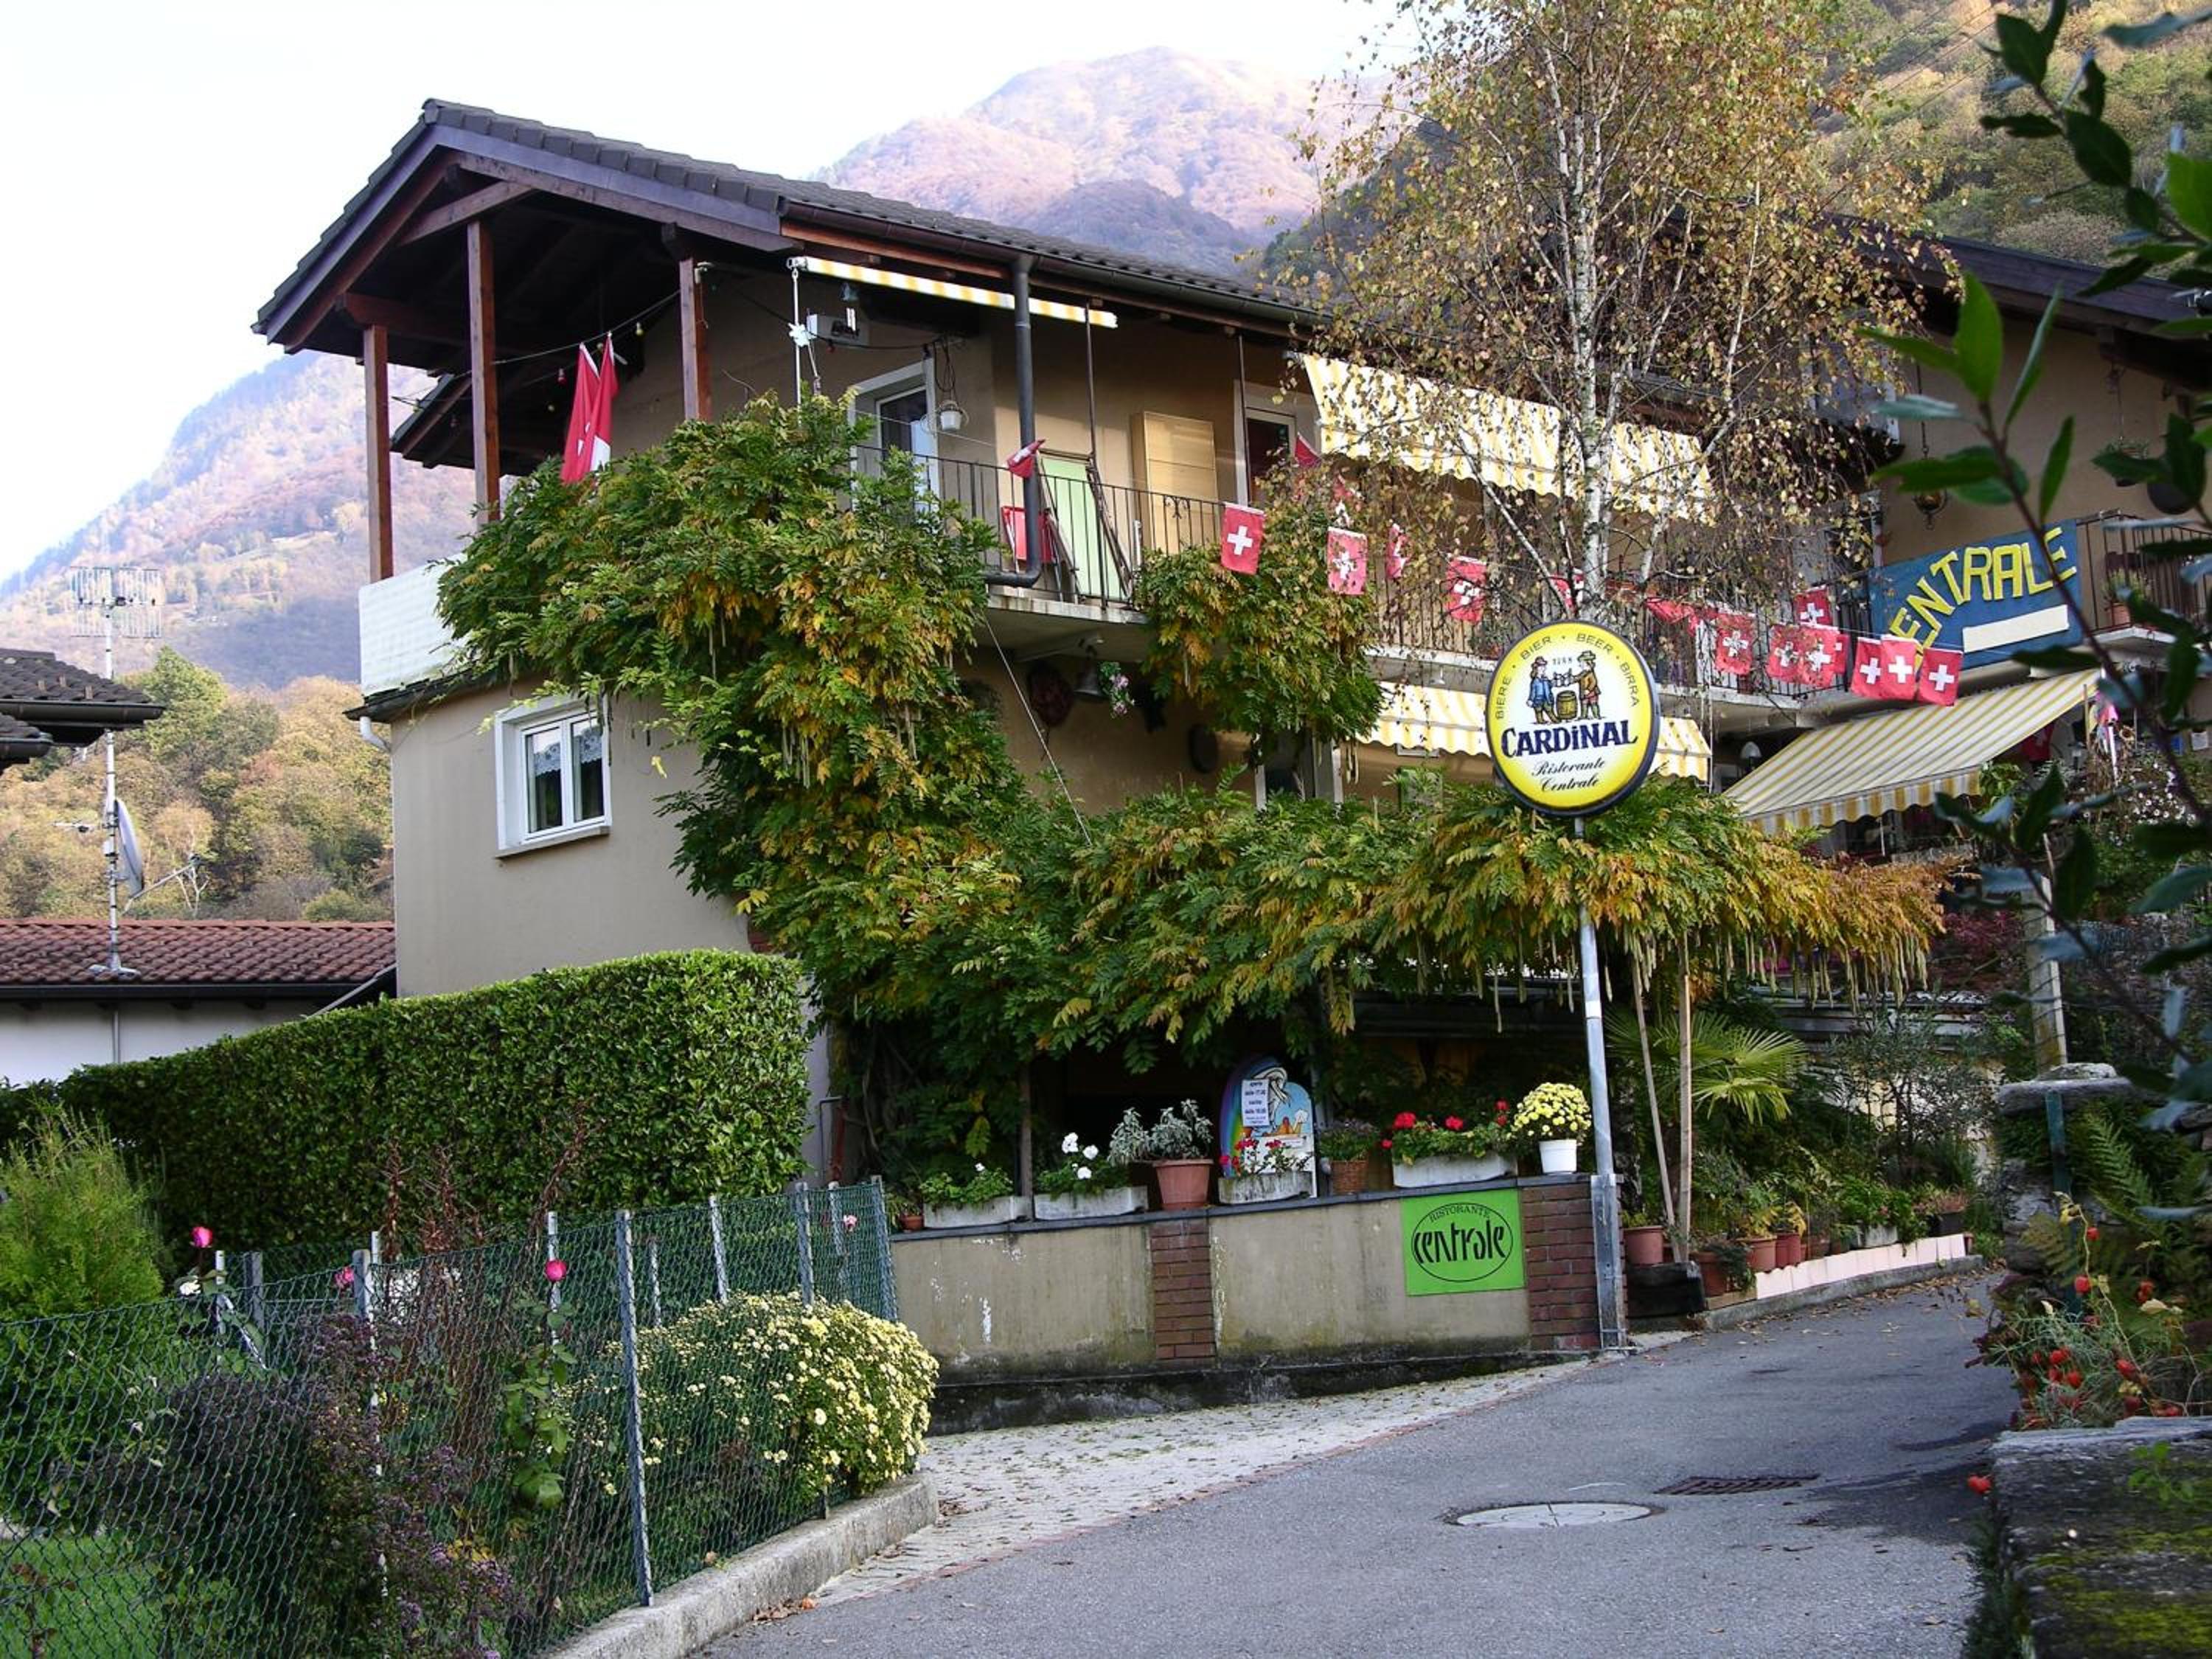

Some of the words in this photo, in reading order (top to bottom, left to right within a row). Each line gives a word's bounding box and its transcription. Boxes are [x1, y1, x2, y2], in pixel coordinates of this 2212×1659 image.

[1889, 526, 2077, 672] ENTRALE
[1520, 636, 1553, 660] BIER
[1576, 633, 1614, 655] BEER
[1620, 661, 1640, 707] BIRRA
[1531, 757, 1606, 776] Ristorante
[1540, 773, 1599, 793] Centrale
[1430, 1205, 1490, 1222] RISTORANTE
